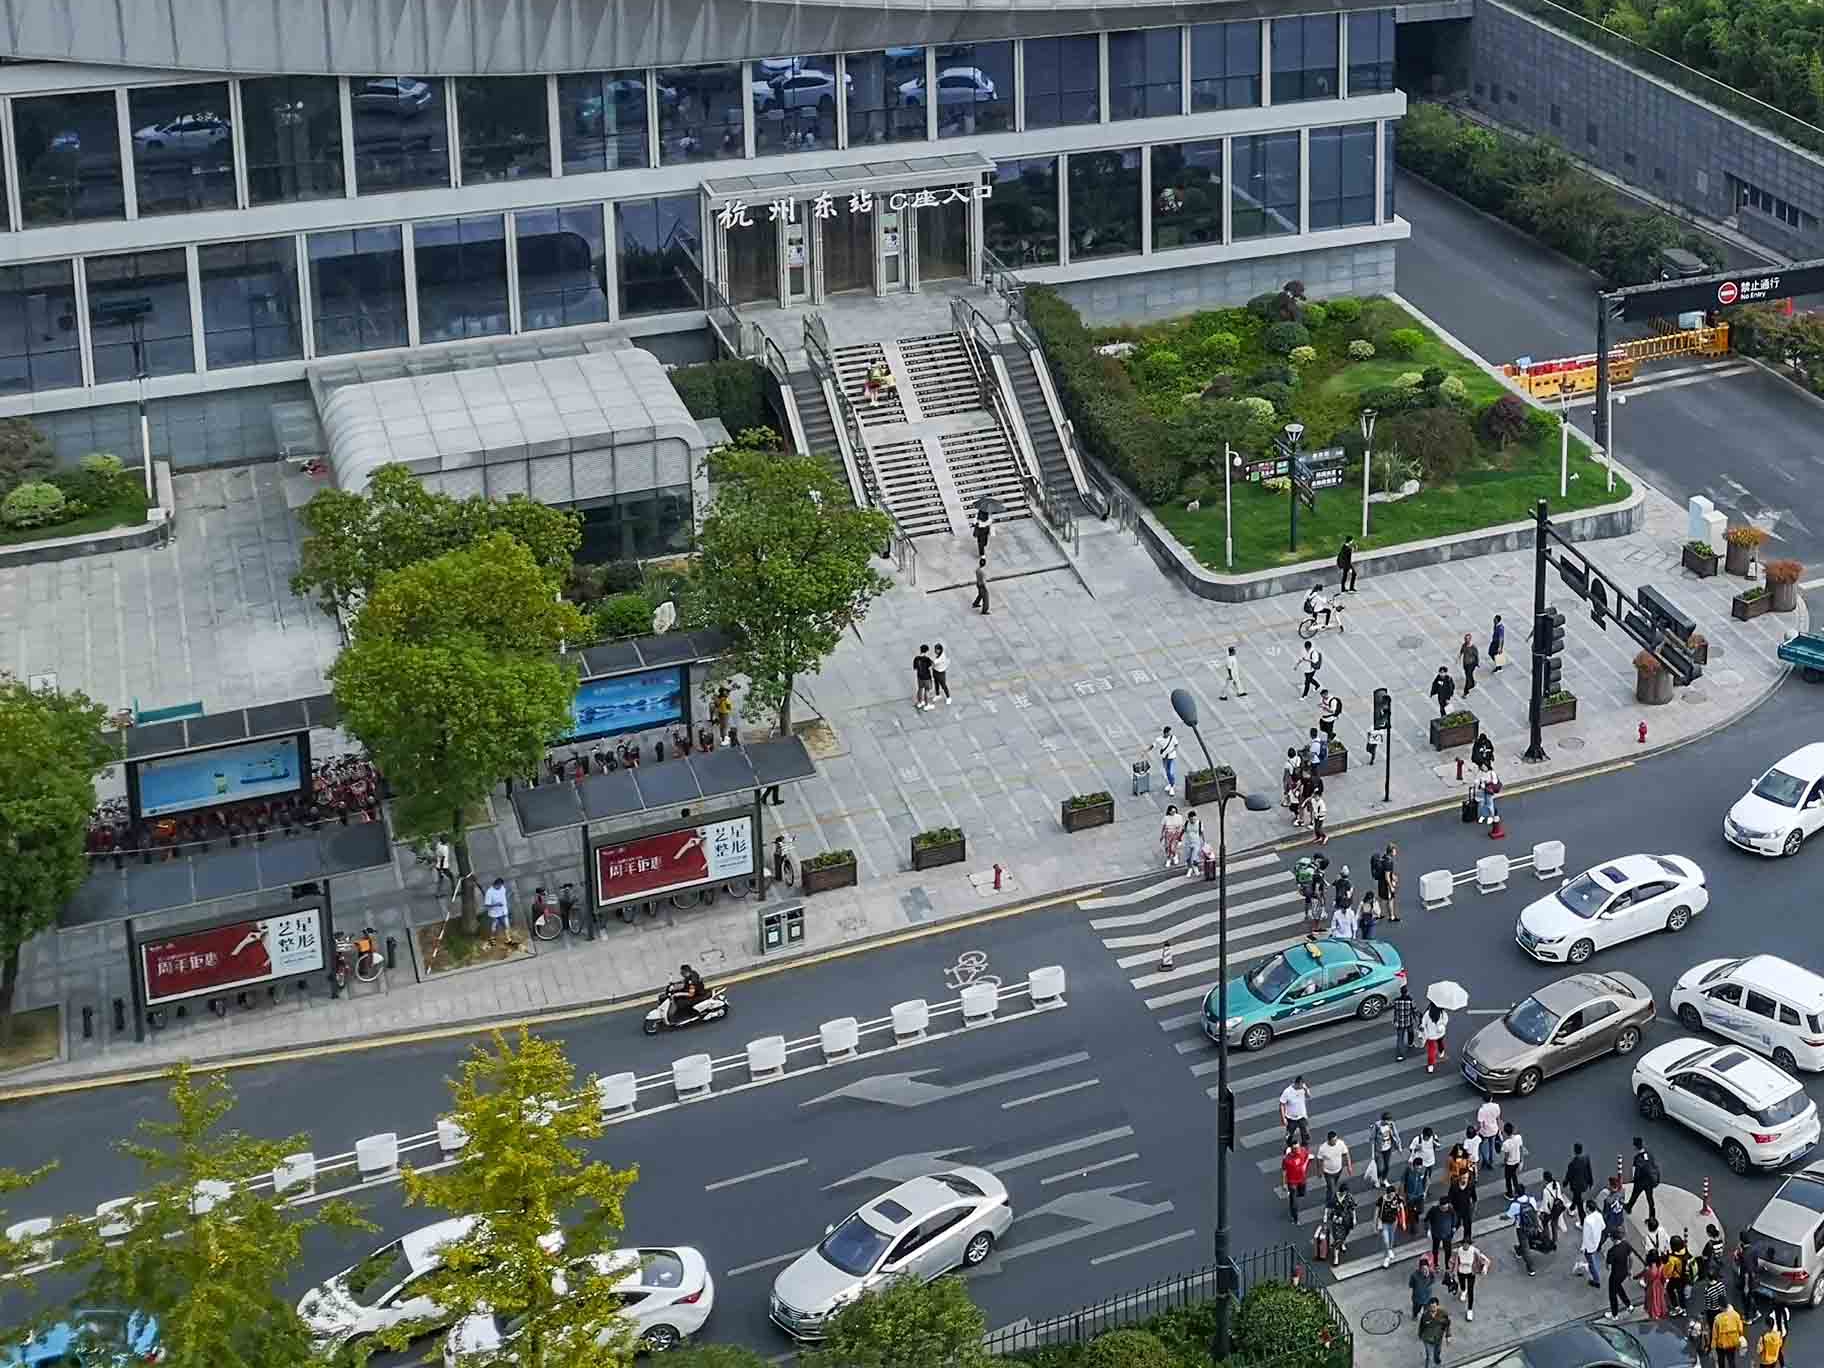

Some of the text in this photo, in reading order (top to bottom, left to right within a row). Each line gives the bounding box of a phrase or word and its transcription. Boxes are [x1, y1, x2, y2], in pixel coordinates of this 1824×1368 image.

[718, 186, 992, 229] 杭州东站 C座入口
[1741, 277, 1780, 292] 禁止通行
[1750, 291, 1766, 299] Entry
